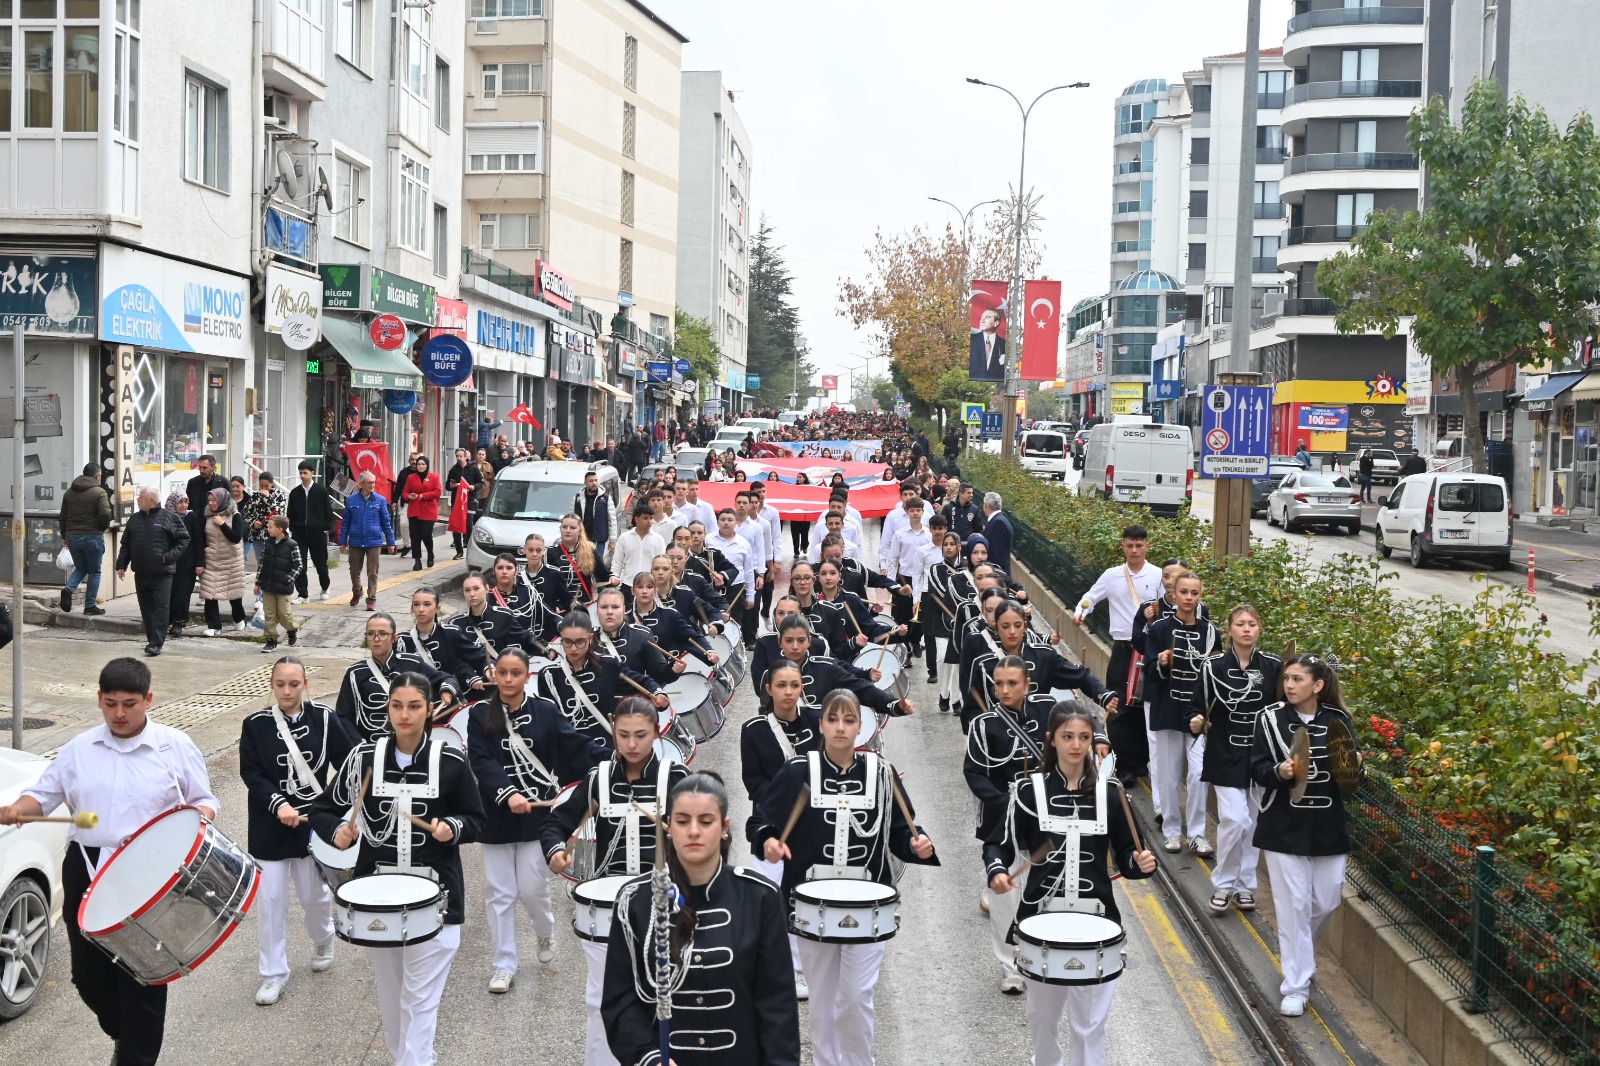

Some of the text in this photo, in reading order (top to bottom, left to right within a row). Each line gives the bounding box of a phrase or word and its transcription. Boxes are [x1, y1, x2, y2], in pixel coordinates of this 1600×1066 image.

[325, 288, 352, 297] BİLGEN
[387, 283, 419, 309] BİLGEN BÜFE
[120, 288, 156, 315] ÇAĞLA
[203, 285, 241, 319] MONO
[328, 297, 348, 307] BÜFE
[3, 315, 26, 326] 0542
[112, 315, 162, 341] ELEKTRİK
[203, 317, 242, 340] ELECTRIC
[431, 351, 460, 361] BİLGEN
[434, 361, 456, 370] BÜFE
[363, 372, 383, 385] BİLGEN BÜFE
[394, 375, 406, 387] BİLGEN
[1366, 369, 1407, 400] ŞOK
[121, 352, 133, 486] ÇAĞLA
[1308, 415, 1324, 425] 100
